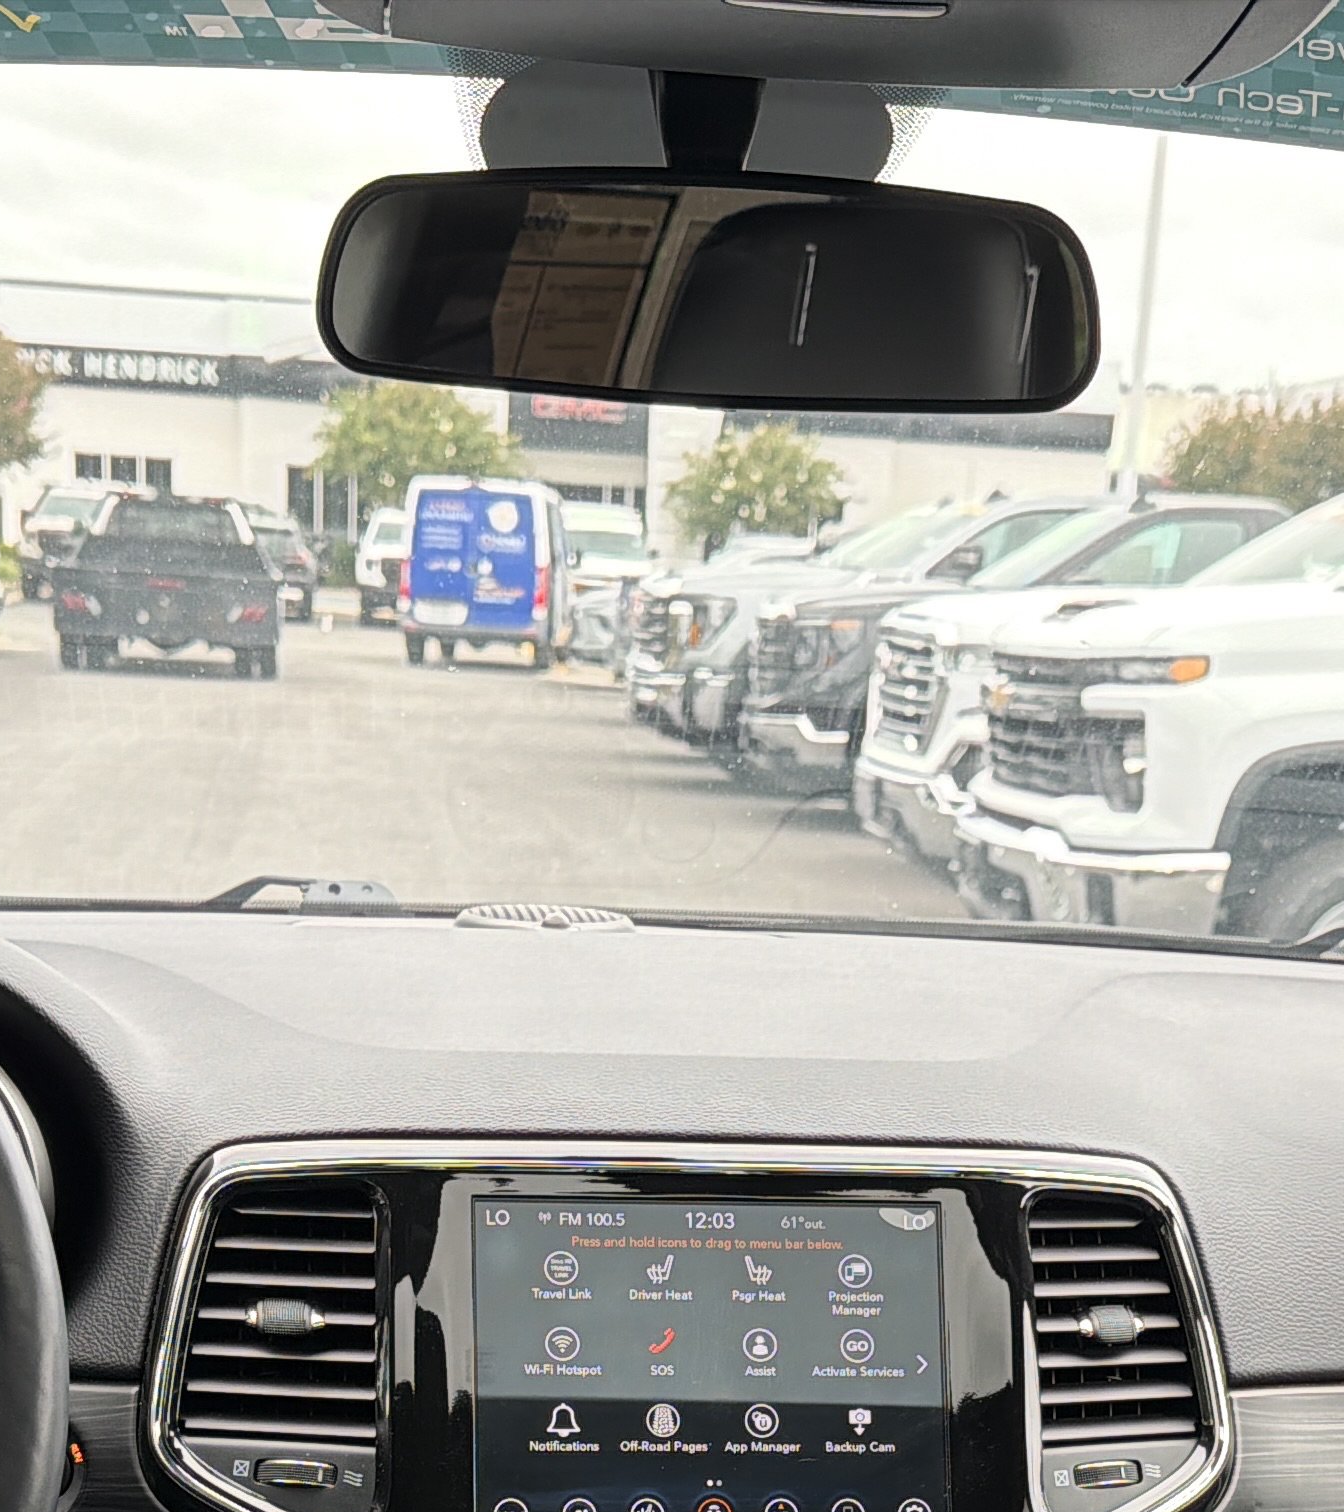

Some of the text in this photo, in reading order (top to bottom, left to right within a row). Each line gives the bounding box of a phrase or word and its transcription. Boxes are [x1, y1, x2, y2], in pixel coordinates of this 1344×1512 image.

[84, 352, 220, 386] HENDRICK
[485, 1210, 511, 1227] LO
[559, 1212, 582, 1227] FM
[586, 1212, 625, 1227] 100.5
[685, 1212, 736, 1230] 12:03
[903, 1215, 927, 1231] LO
[571, 1236, 844, 1252] Press and hold icons to drag to menu bar below.
[531, 1288, 592, 1300] Travel Link
[629, 1289, 693, 1301] Driver Heat
[732, 1290, 786, 1303] Psgr Heat
[828, 1291, 884, 1305] Projection
[832, 1305, 881, 1318] Manager
[846, 1340, 869, 1352] GO
[524, 1364, 602, 1378] Wi-Fi Hotspot
[650, 1365, 674, 1377] SOS
[745, 1365, 776, 1377] Assist
[812, 1365, 905, 1378] Activate Services
[529, 1440, 599, 1452] Notifications
[620, 1440, 708, 1454] Off-Road Pages
[724, 1441, 801, 1455] App Manager
[825, 1442, 896, 1455] Backup Cam
